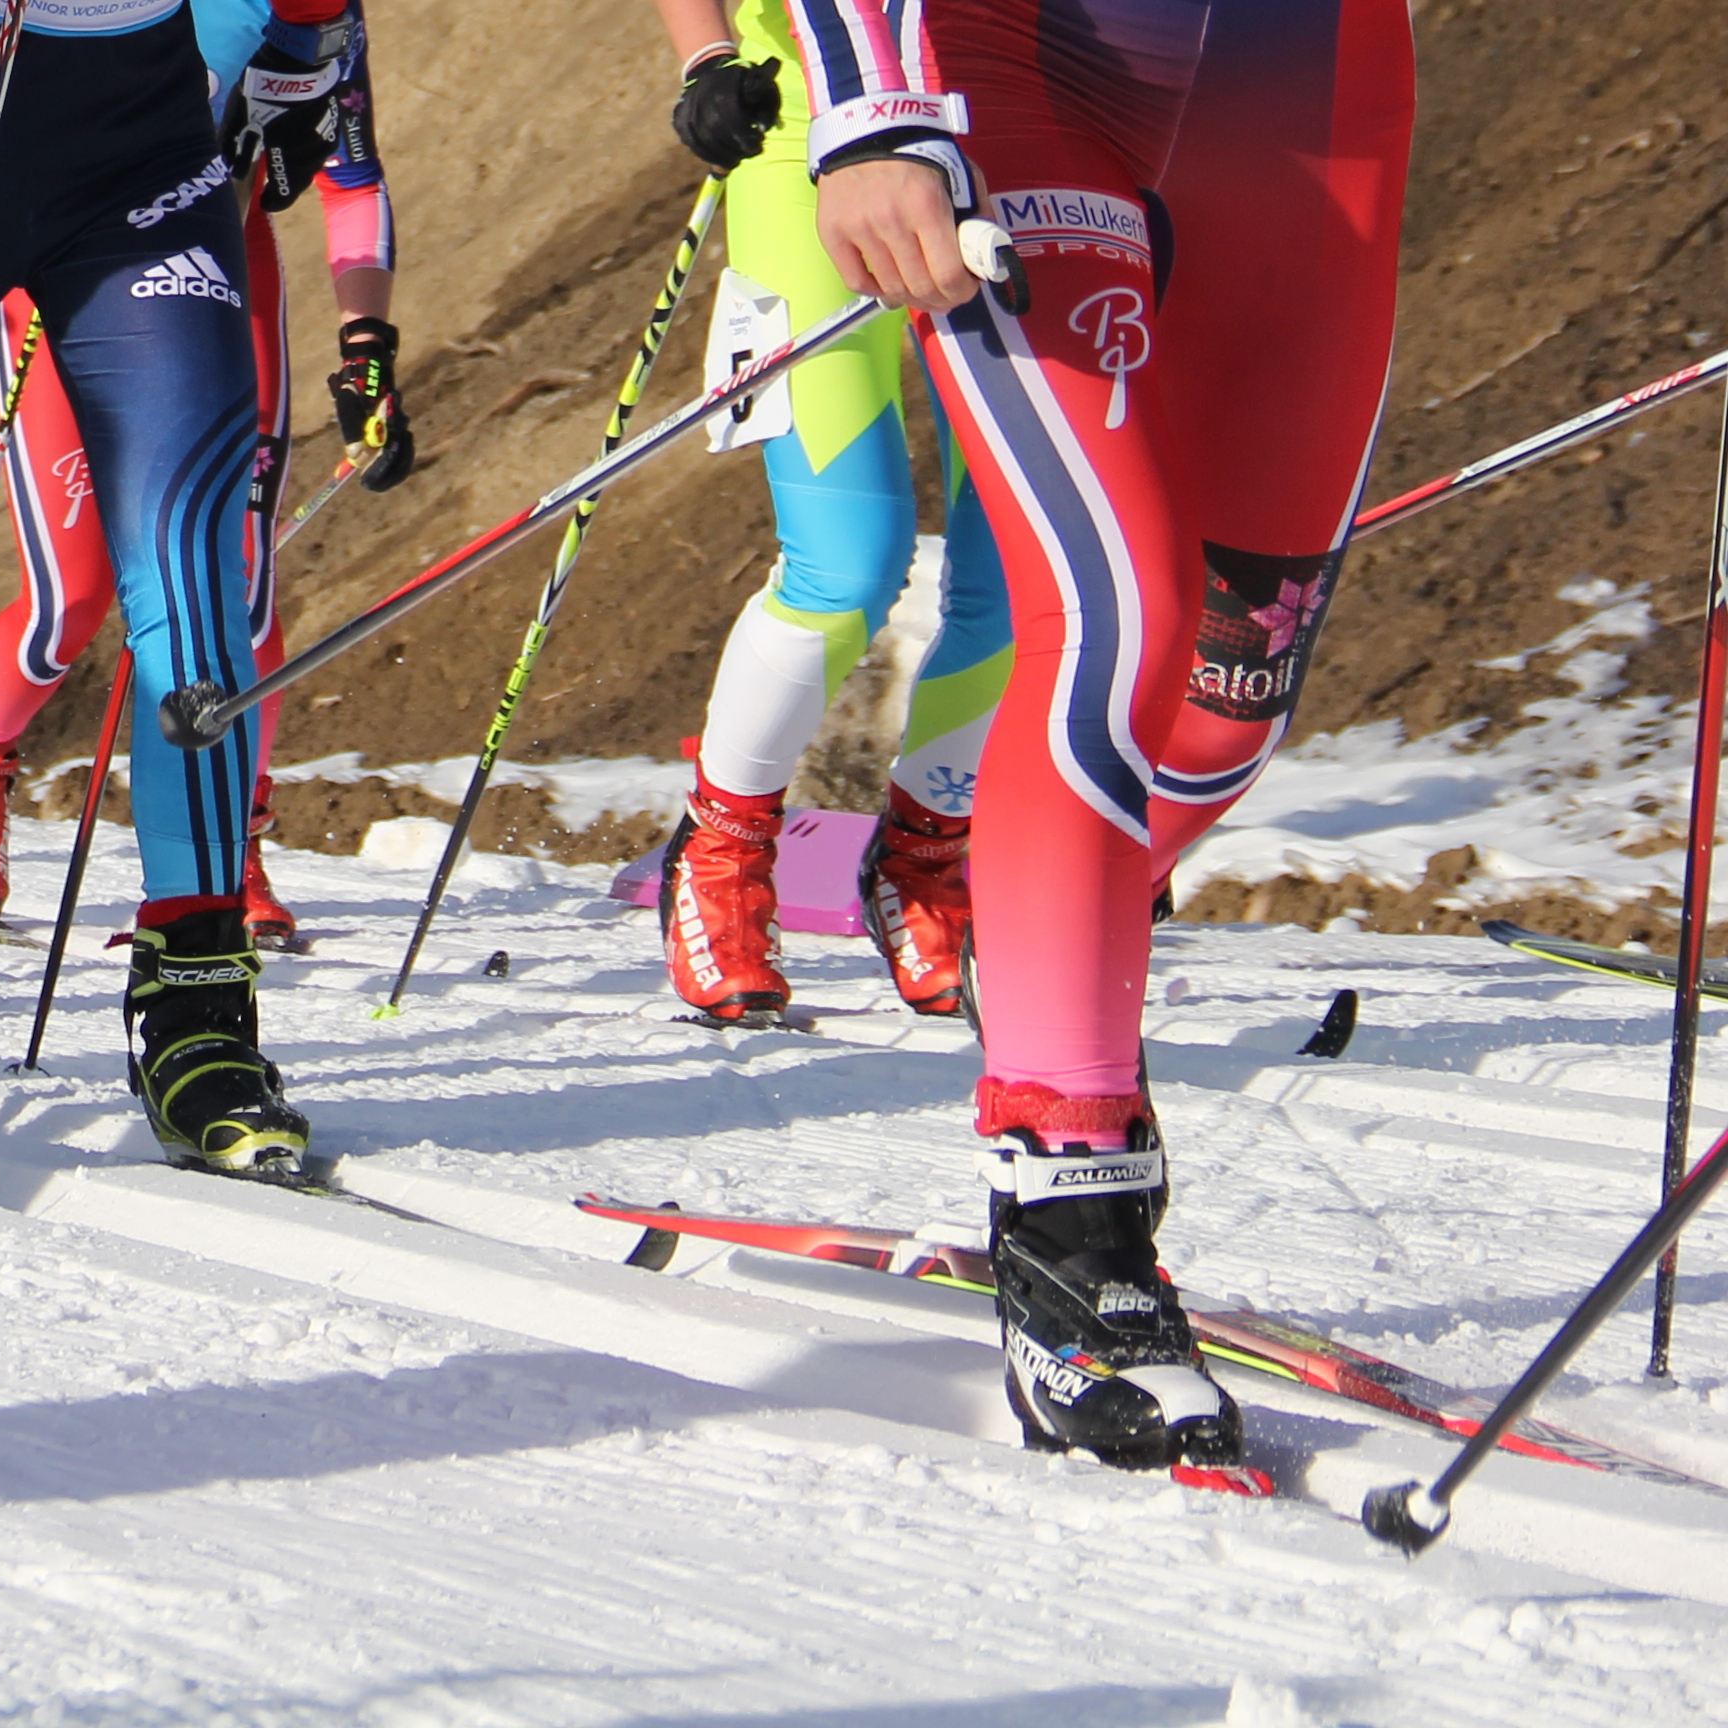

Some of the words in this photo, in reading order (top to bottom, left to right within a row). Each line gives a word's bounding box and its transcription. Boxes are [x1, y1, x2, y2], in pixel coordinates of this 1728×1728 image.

[72, 2, 119, 18] WORLD
[270, 147, 290, 197] adidas
[129, 275, 242, 310] adidas
[365, 359, 381, 398] LEKI
[1056, 1163, 1154, 1185] SALOMON
